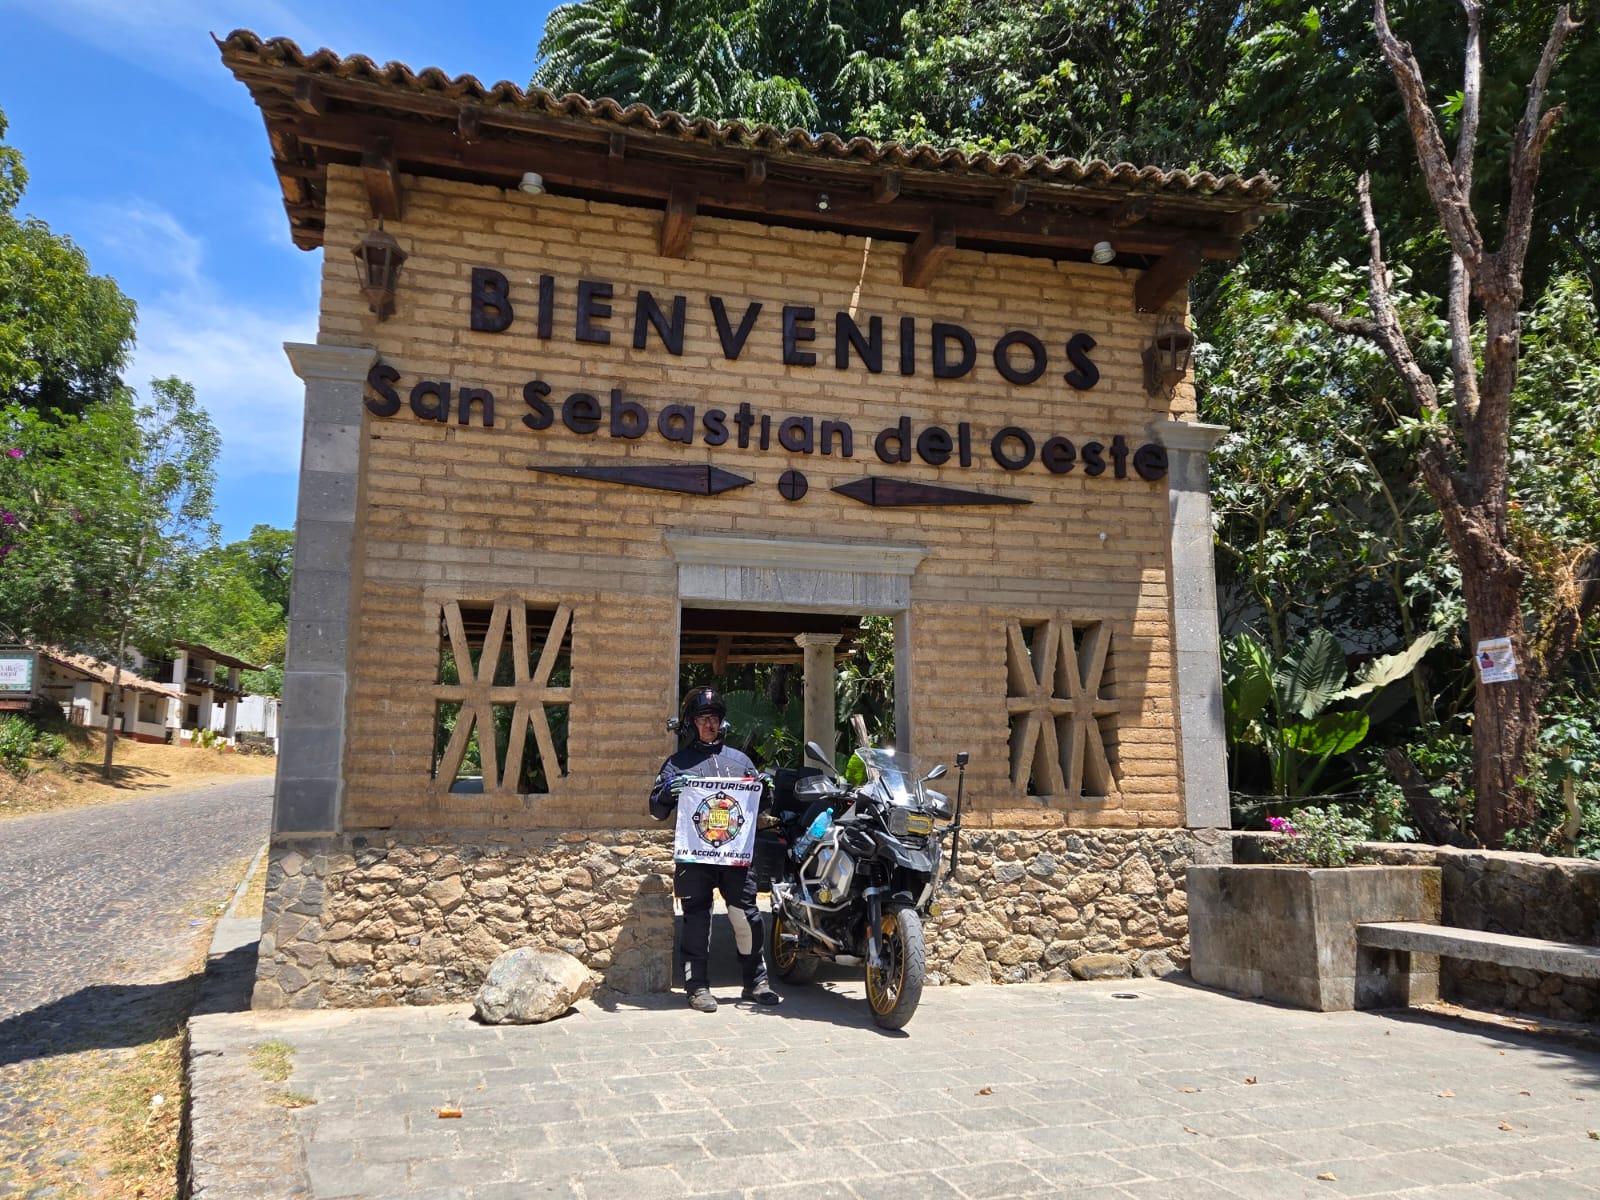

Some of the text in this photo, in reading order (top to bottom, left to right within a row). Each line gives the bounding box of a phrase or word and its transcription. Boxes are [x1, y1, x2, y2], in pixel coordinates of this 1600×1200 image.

[470, 267, 1099, 390] BIENVENIDOS
[365, 365, 494, 427] San
[874, 416, 972, 467] del
[991, 426, 1168, 481] Oeste
[691, 849, 721, 857] ACCIÓN
[724, 850, 751, 859] MÉXICO
